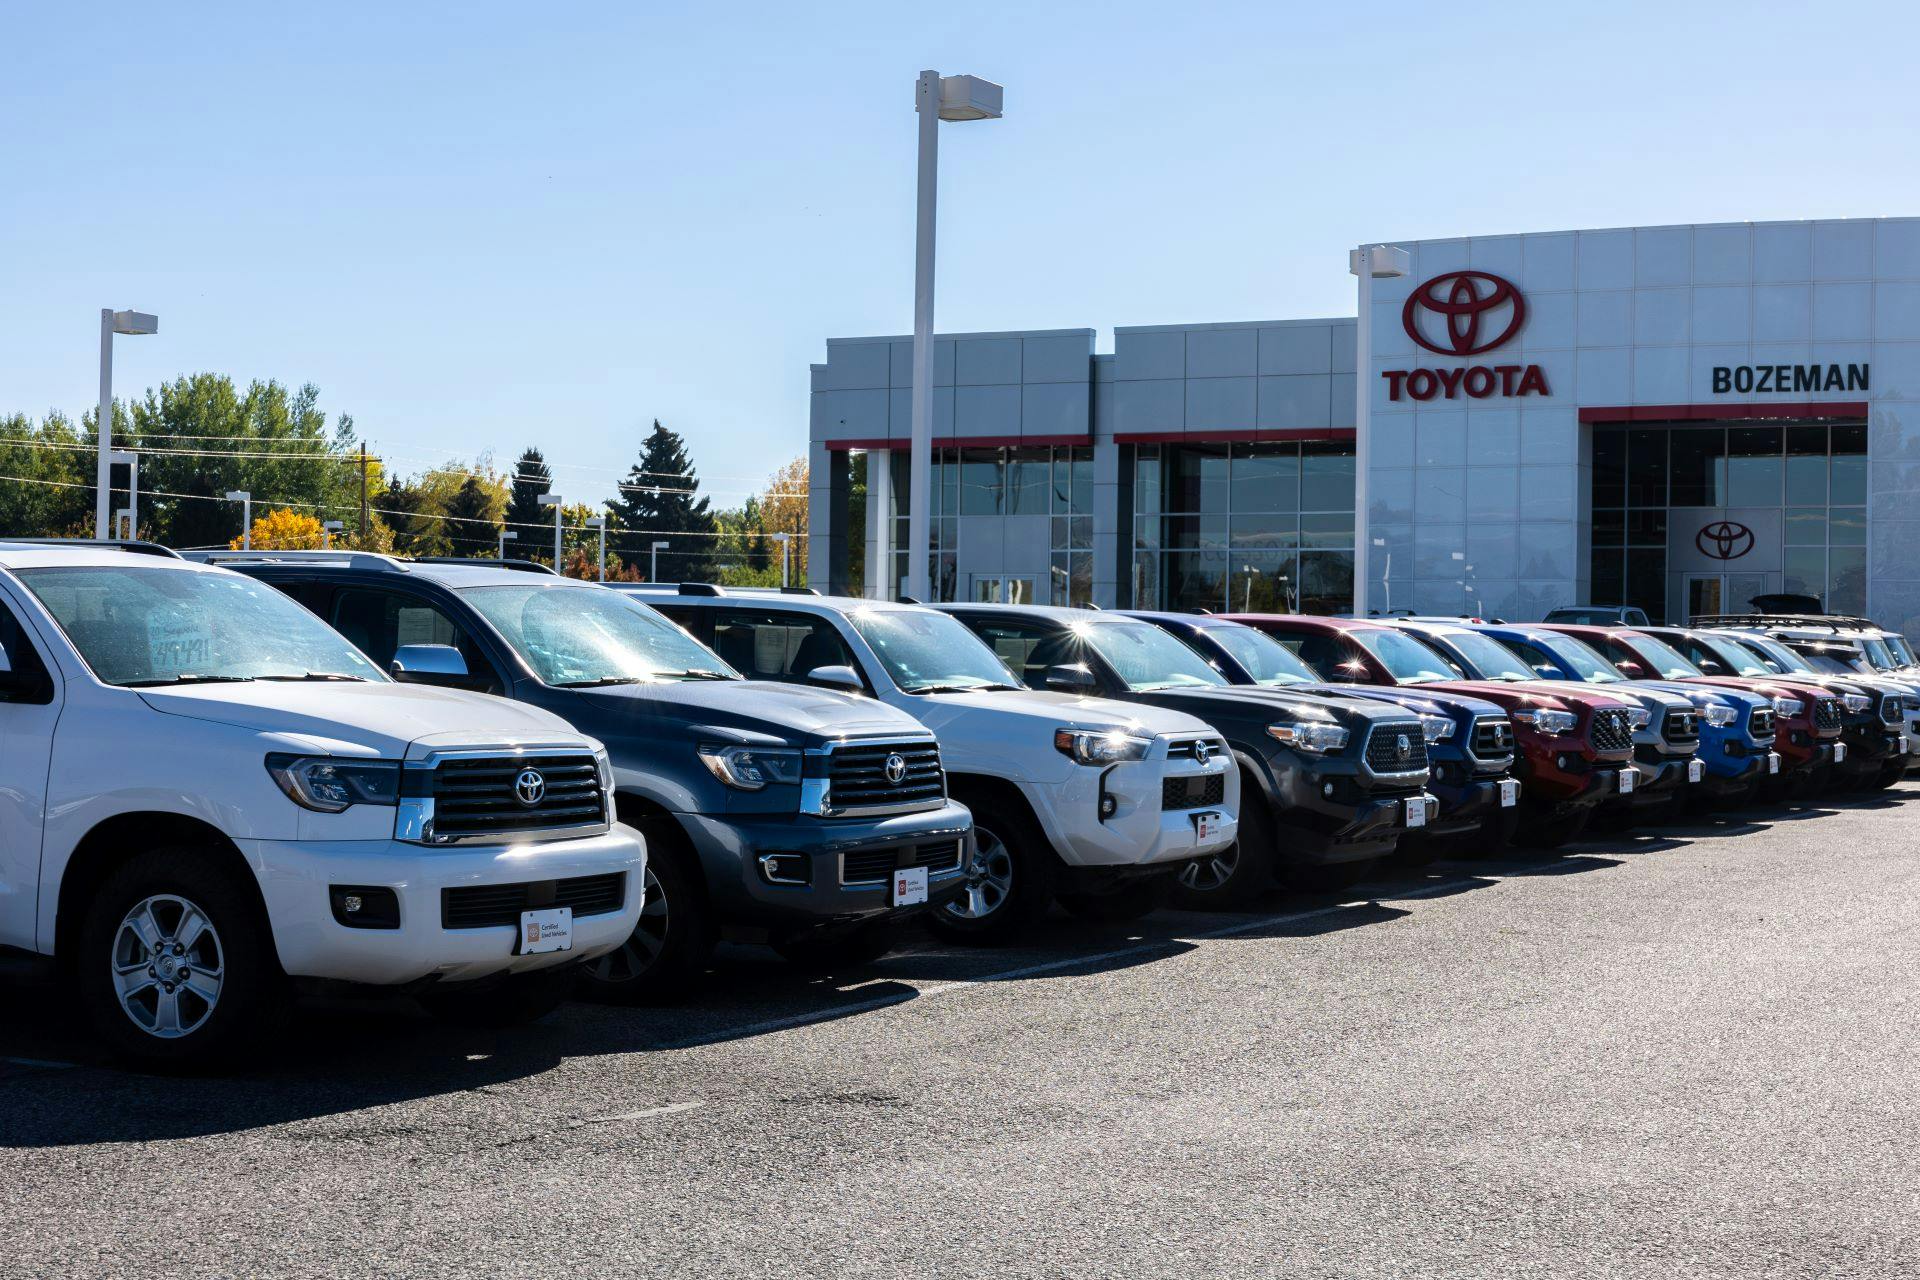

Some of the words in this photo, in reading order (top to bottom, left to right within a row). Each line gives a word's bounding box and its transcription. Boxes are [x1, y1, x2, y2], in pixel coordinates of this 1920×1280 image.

[1382, 364, 1550, 401] TOYOTA
[1712, 363, 1869, 394] BOZEMAN
[1190, 540, 1323, 561] ACCESSORES
